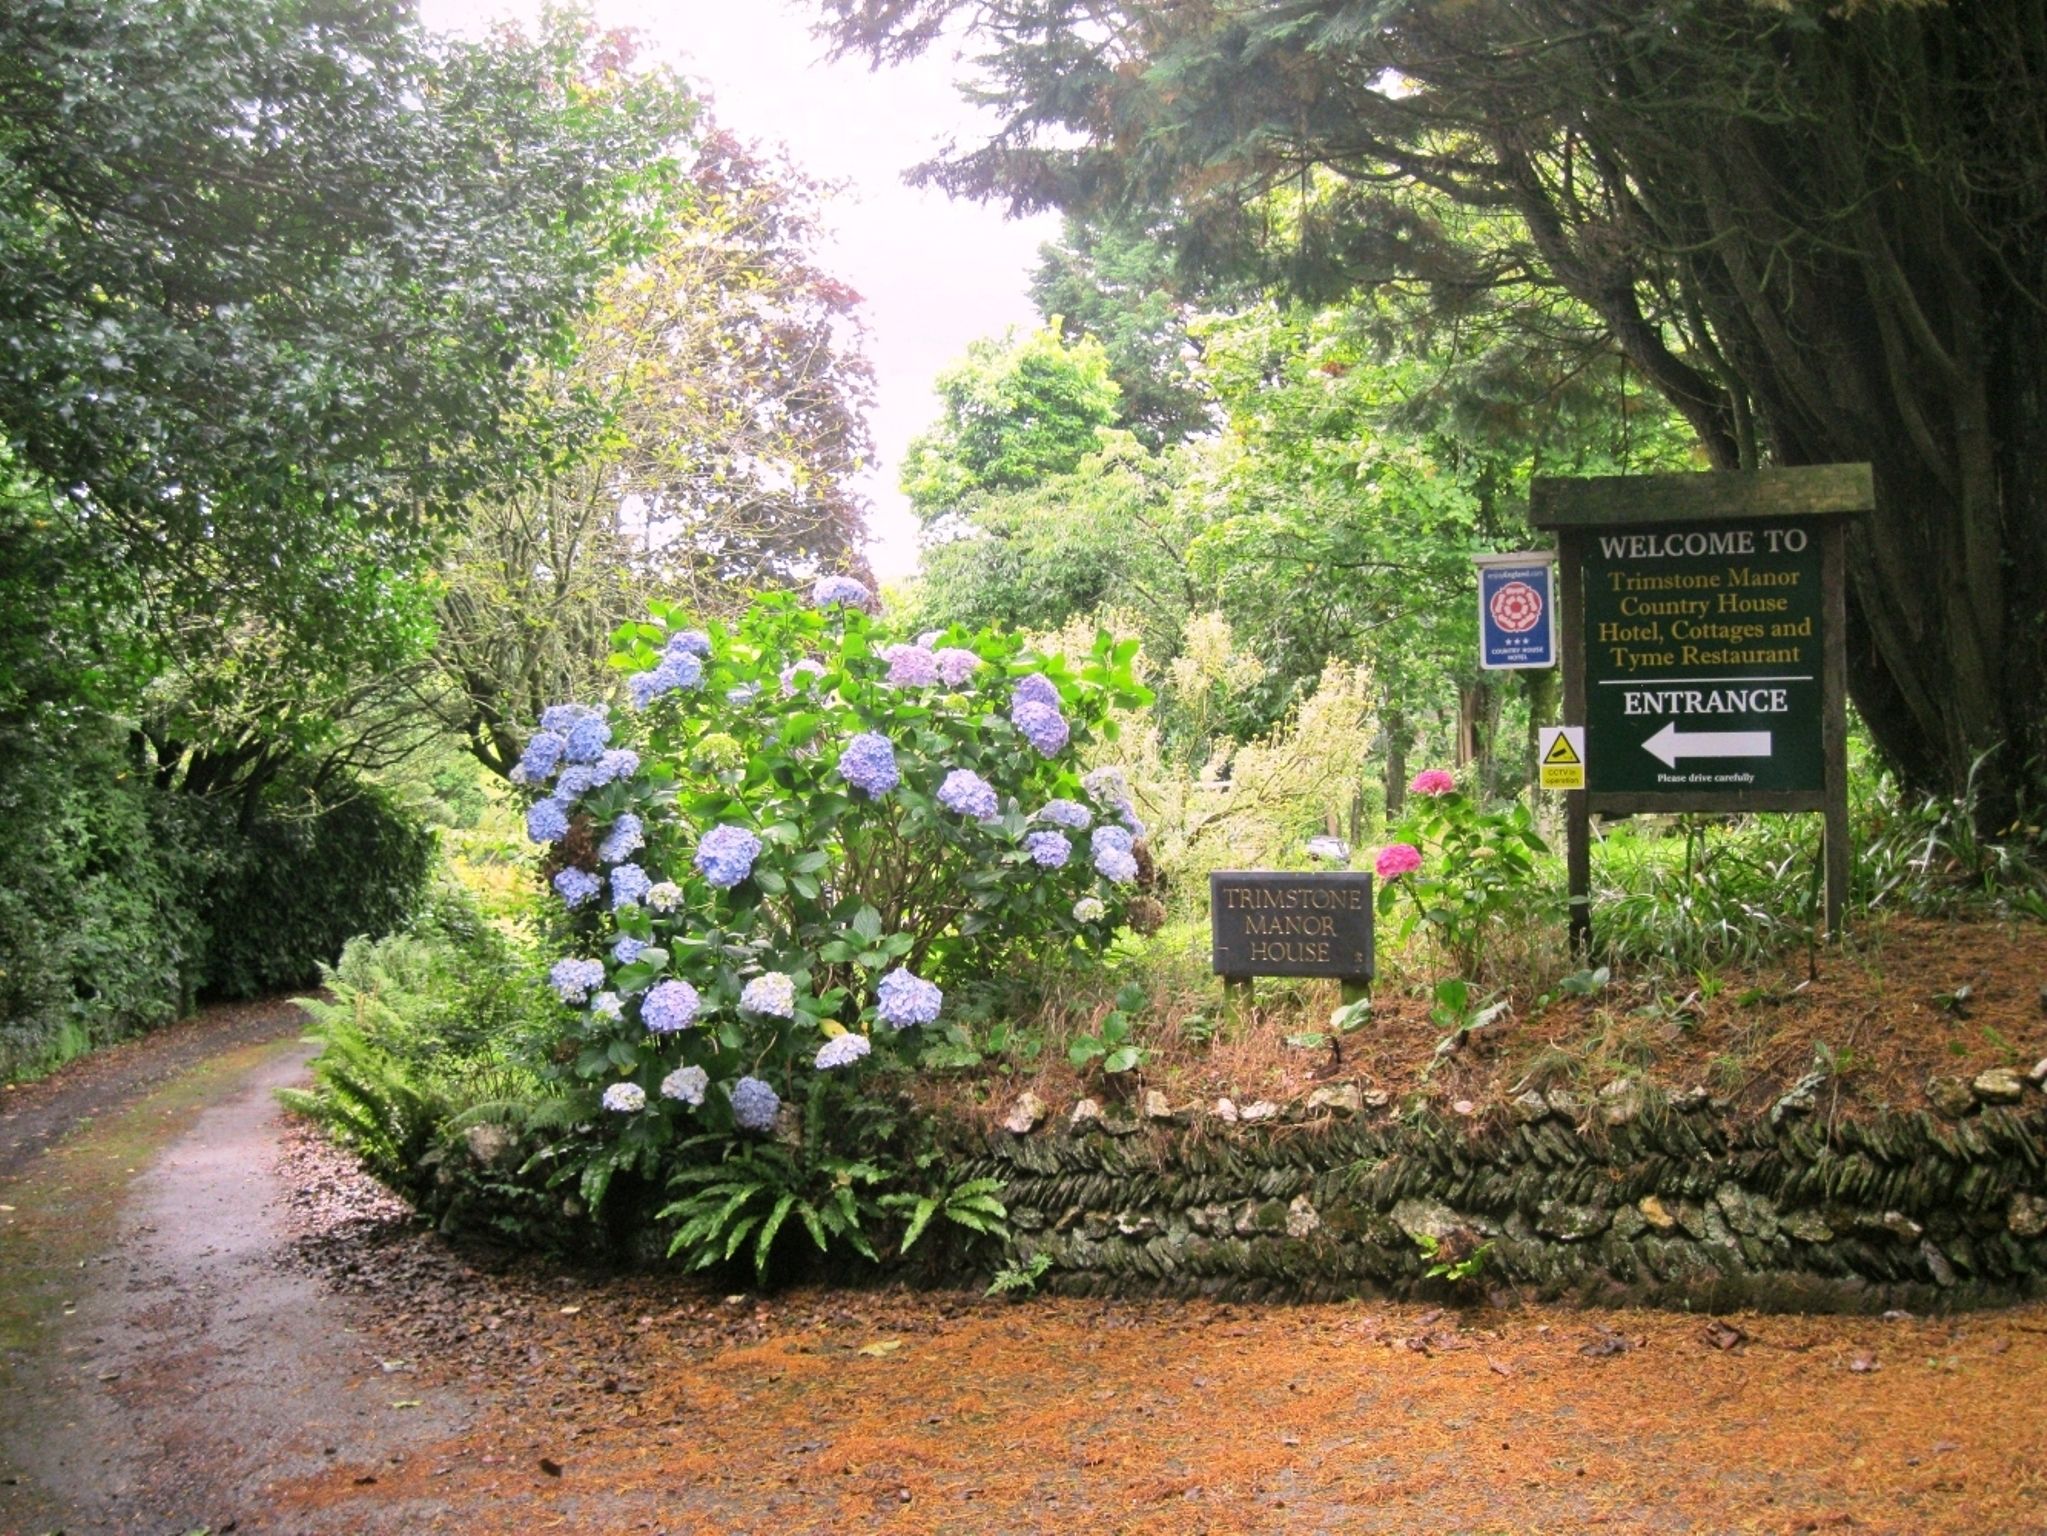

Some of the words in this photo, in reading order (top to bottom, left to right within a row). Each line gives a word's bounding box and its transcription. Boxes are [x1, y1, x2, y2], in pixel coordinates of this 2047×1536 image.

[1599, 531, 1755, 559] WELCOME
[1764, 528, 1807, 552] TO
[1607, 571, 1720, 591] Trimstone
[1727, 567, 1800, 587] Manor
[1620, 596, 1710, 618] Country
[1717, 593, 1788, 613] House
[1598, 621, 1664, 644] Hotel,
[1671, 619, 1764, 644] Cottages
[1771, 616, 1812, 636] and
[1491, 647, 1520, 655] COUNTRY
[1522, 646, 1544, 654] HOUSE
[1610, 647, 1674, 671] Tyme
[1681, 645, 1800, 666] Restaurant
[1624, 689, 1788, 715] ENTRANCE
[1545, 777, 1579, 785] operation
[1657, 773, 1687, 783] Please
[1688, 773, 1712, 783] drive
[1714, 772, 1755, 784] carefully
[1223, 888, 1362, 910] TRIMSTONE
[1244, 915, 1337, 938] MANOR
[1250, 941, 1331, 963] HOUSE
